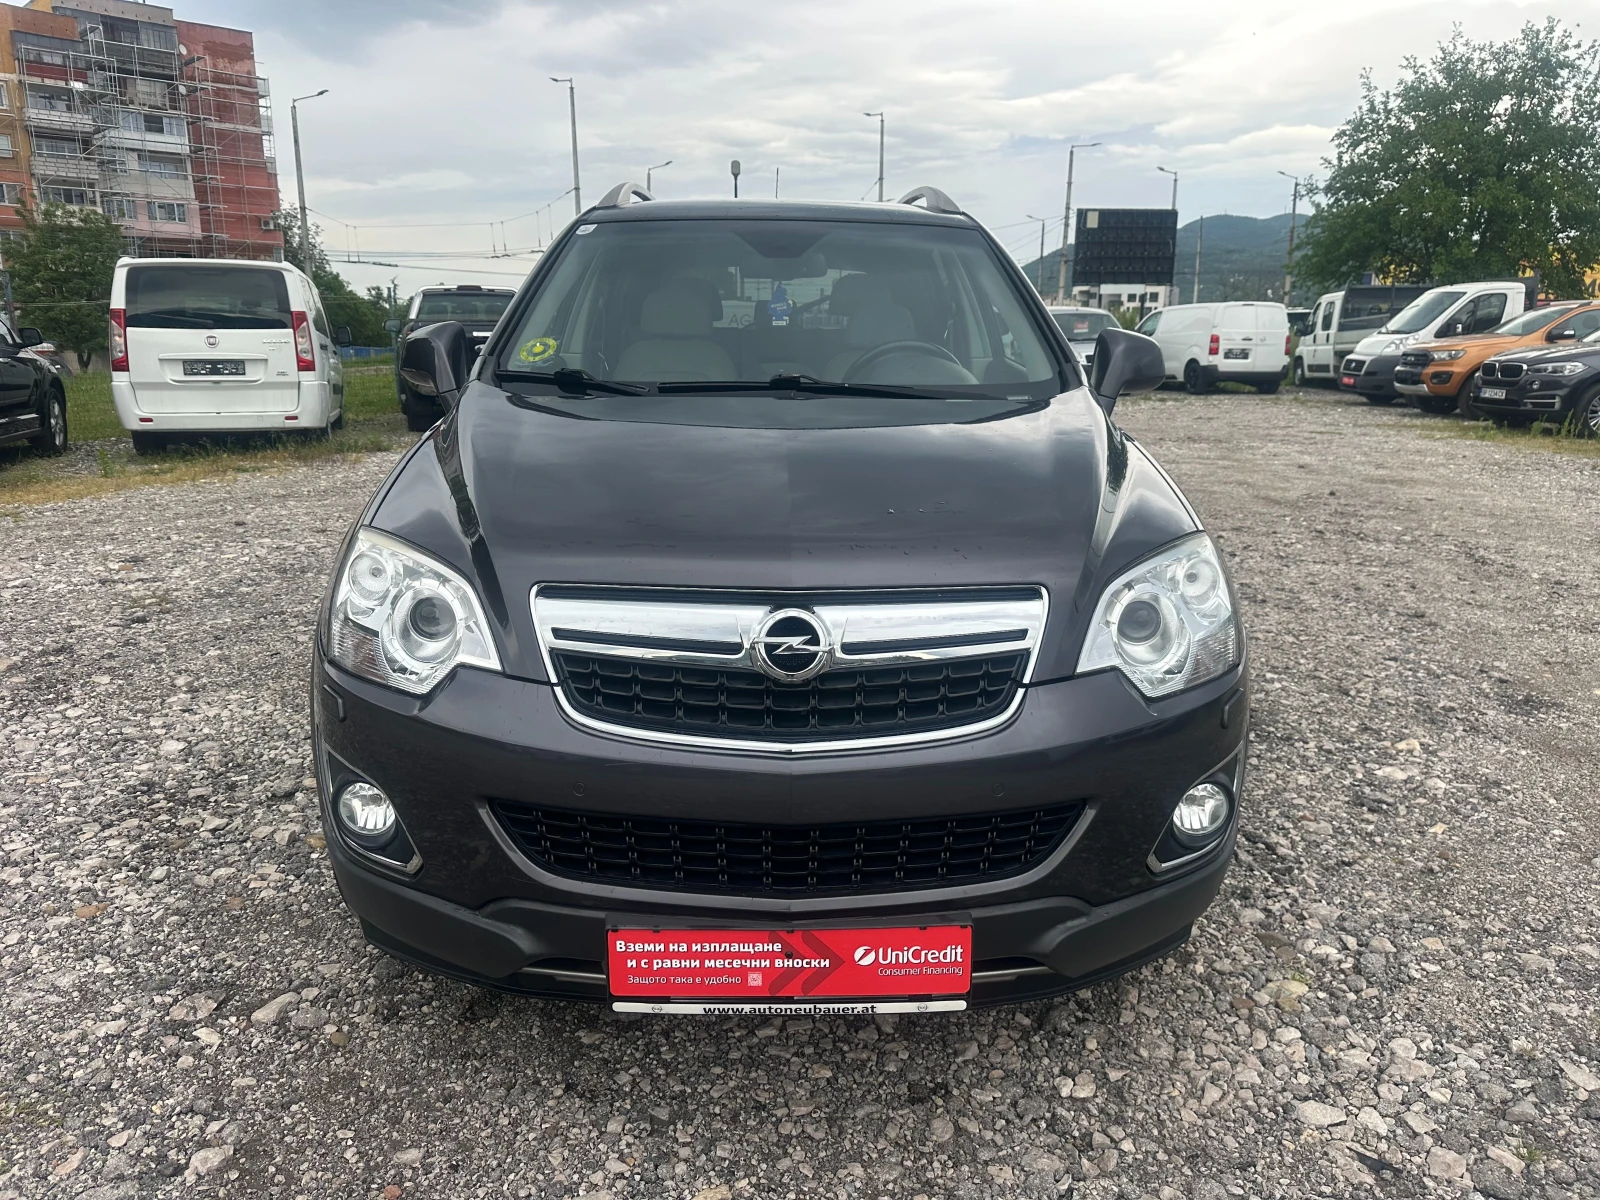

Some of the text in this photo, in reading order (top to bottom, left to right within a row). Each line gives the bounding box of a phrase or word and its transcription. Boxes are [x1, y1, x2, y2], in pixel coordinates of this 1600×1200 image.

[615, 940, 782, 954] Вземи на изплащане
[878, 944, 964, 964] UniCredit
[627, 958, 830, 970] и с равни месечни вноски
[878, 966, 963, 976] Consumer Financing
[627, 974, 742, 986] Защото така е удобно
[703, 1005, 877, 1015] www.autoneubauer.at
